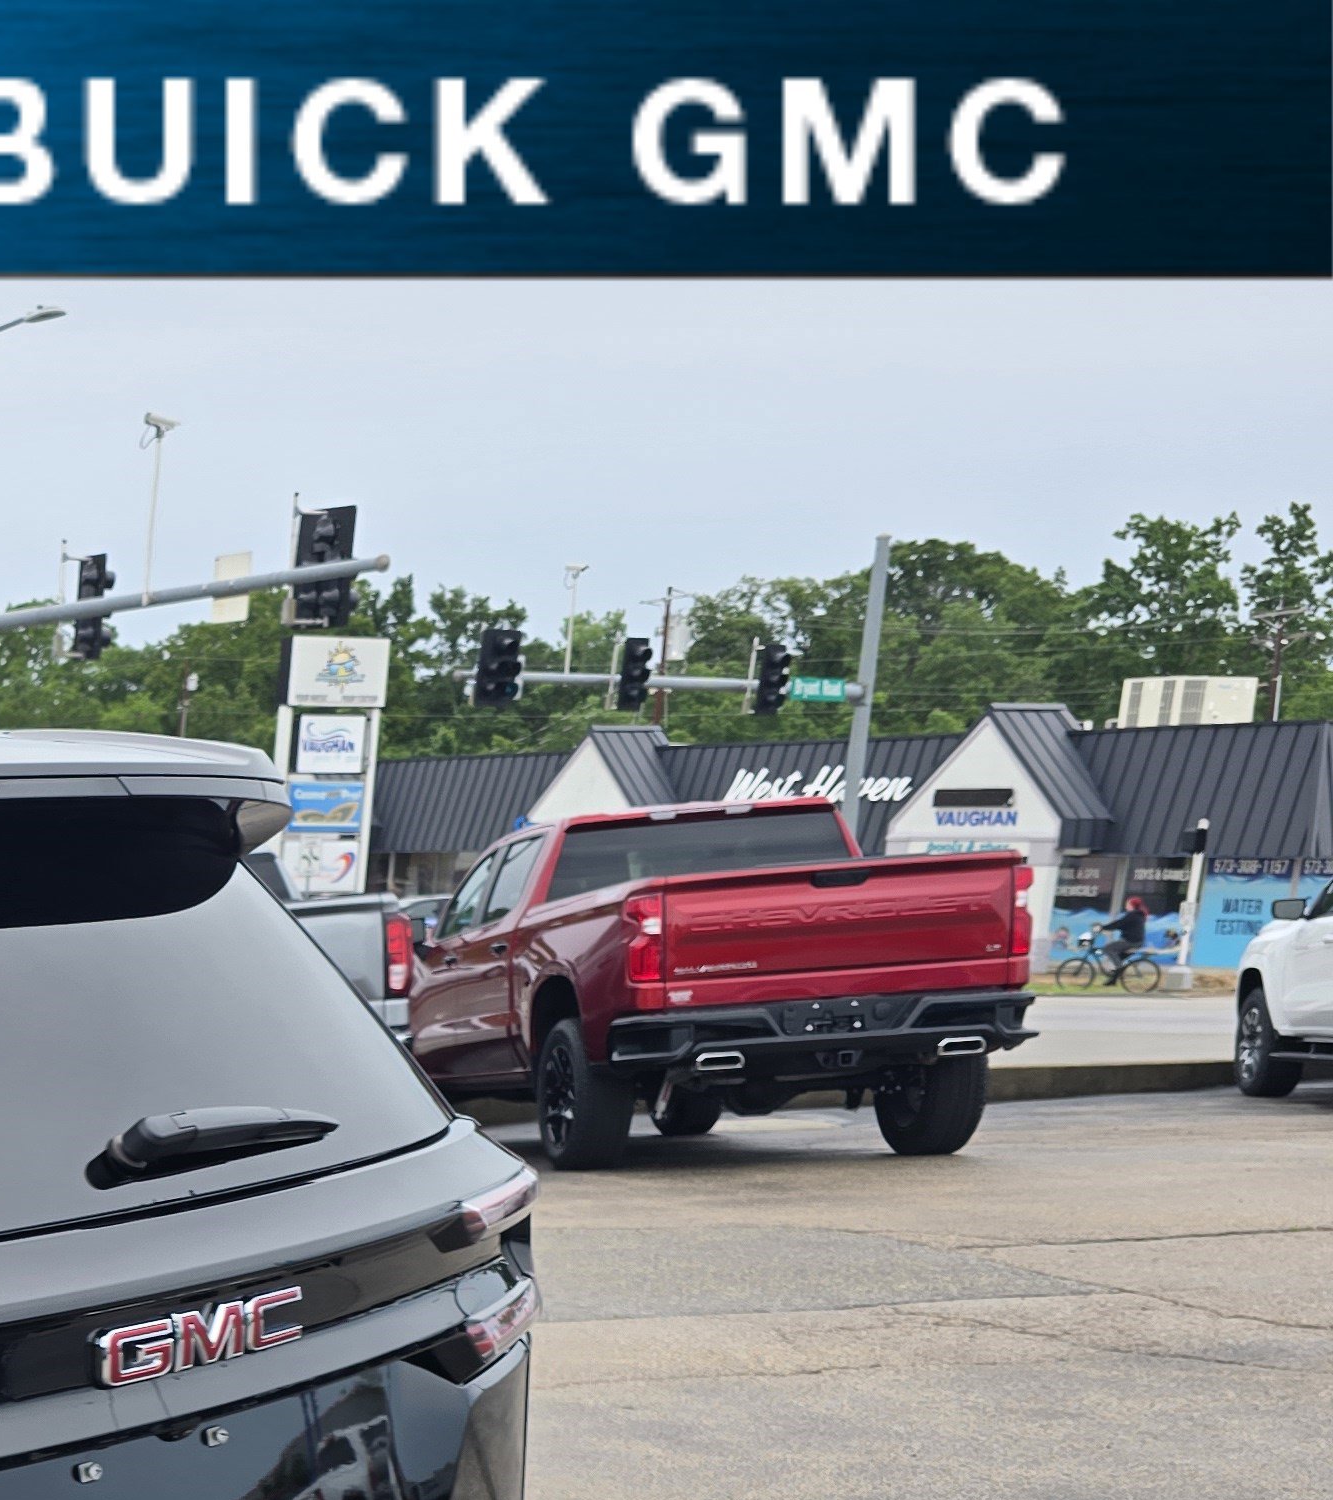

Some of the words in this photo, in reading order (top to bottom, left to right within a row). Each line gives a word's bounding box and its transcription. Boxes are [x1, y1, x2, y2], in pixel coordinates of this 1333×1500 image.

[722, 767, 803, 800] West
[935, 811, 1018, 826] VAUGHAN
[1222, 899, 1263, 915] WATER
[90, 1285, 303, 1388] GMC
